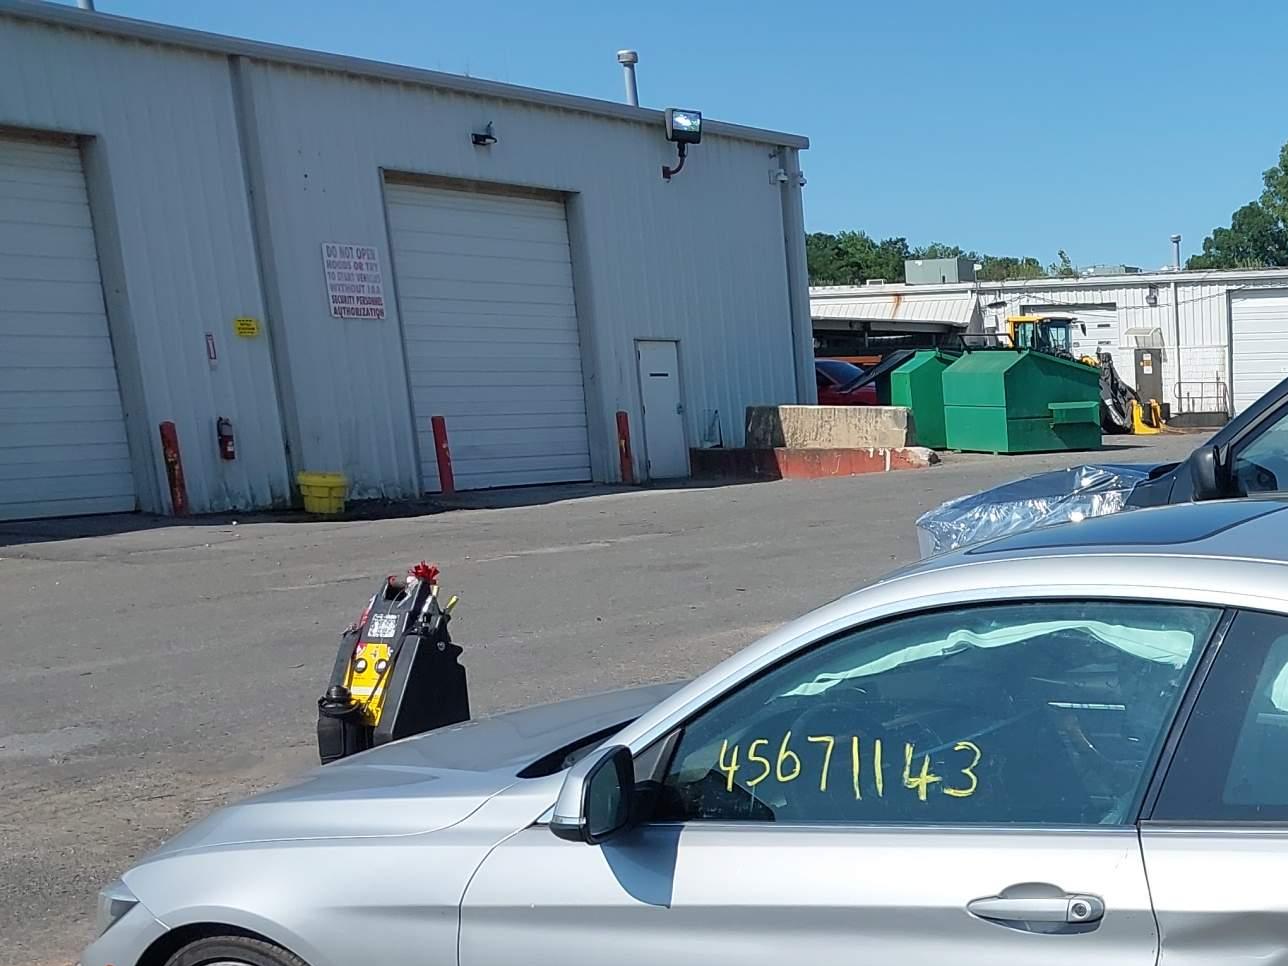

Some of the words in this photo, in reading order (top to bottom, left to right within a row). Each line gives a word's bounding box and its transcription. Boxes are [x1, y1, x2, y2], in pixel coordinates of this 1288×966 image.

[326, 245, 337, 258] DO
[339, 246, 353, 259] NOT
[356, 247, 376, 260] OPEN
[354, 261, 364, 271] OR
[331, 294, 355, 305] SECURITY
[333, 306, 385, 317] AUTHORIZATION
[718, 730, 982, 801] 45671143
